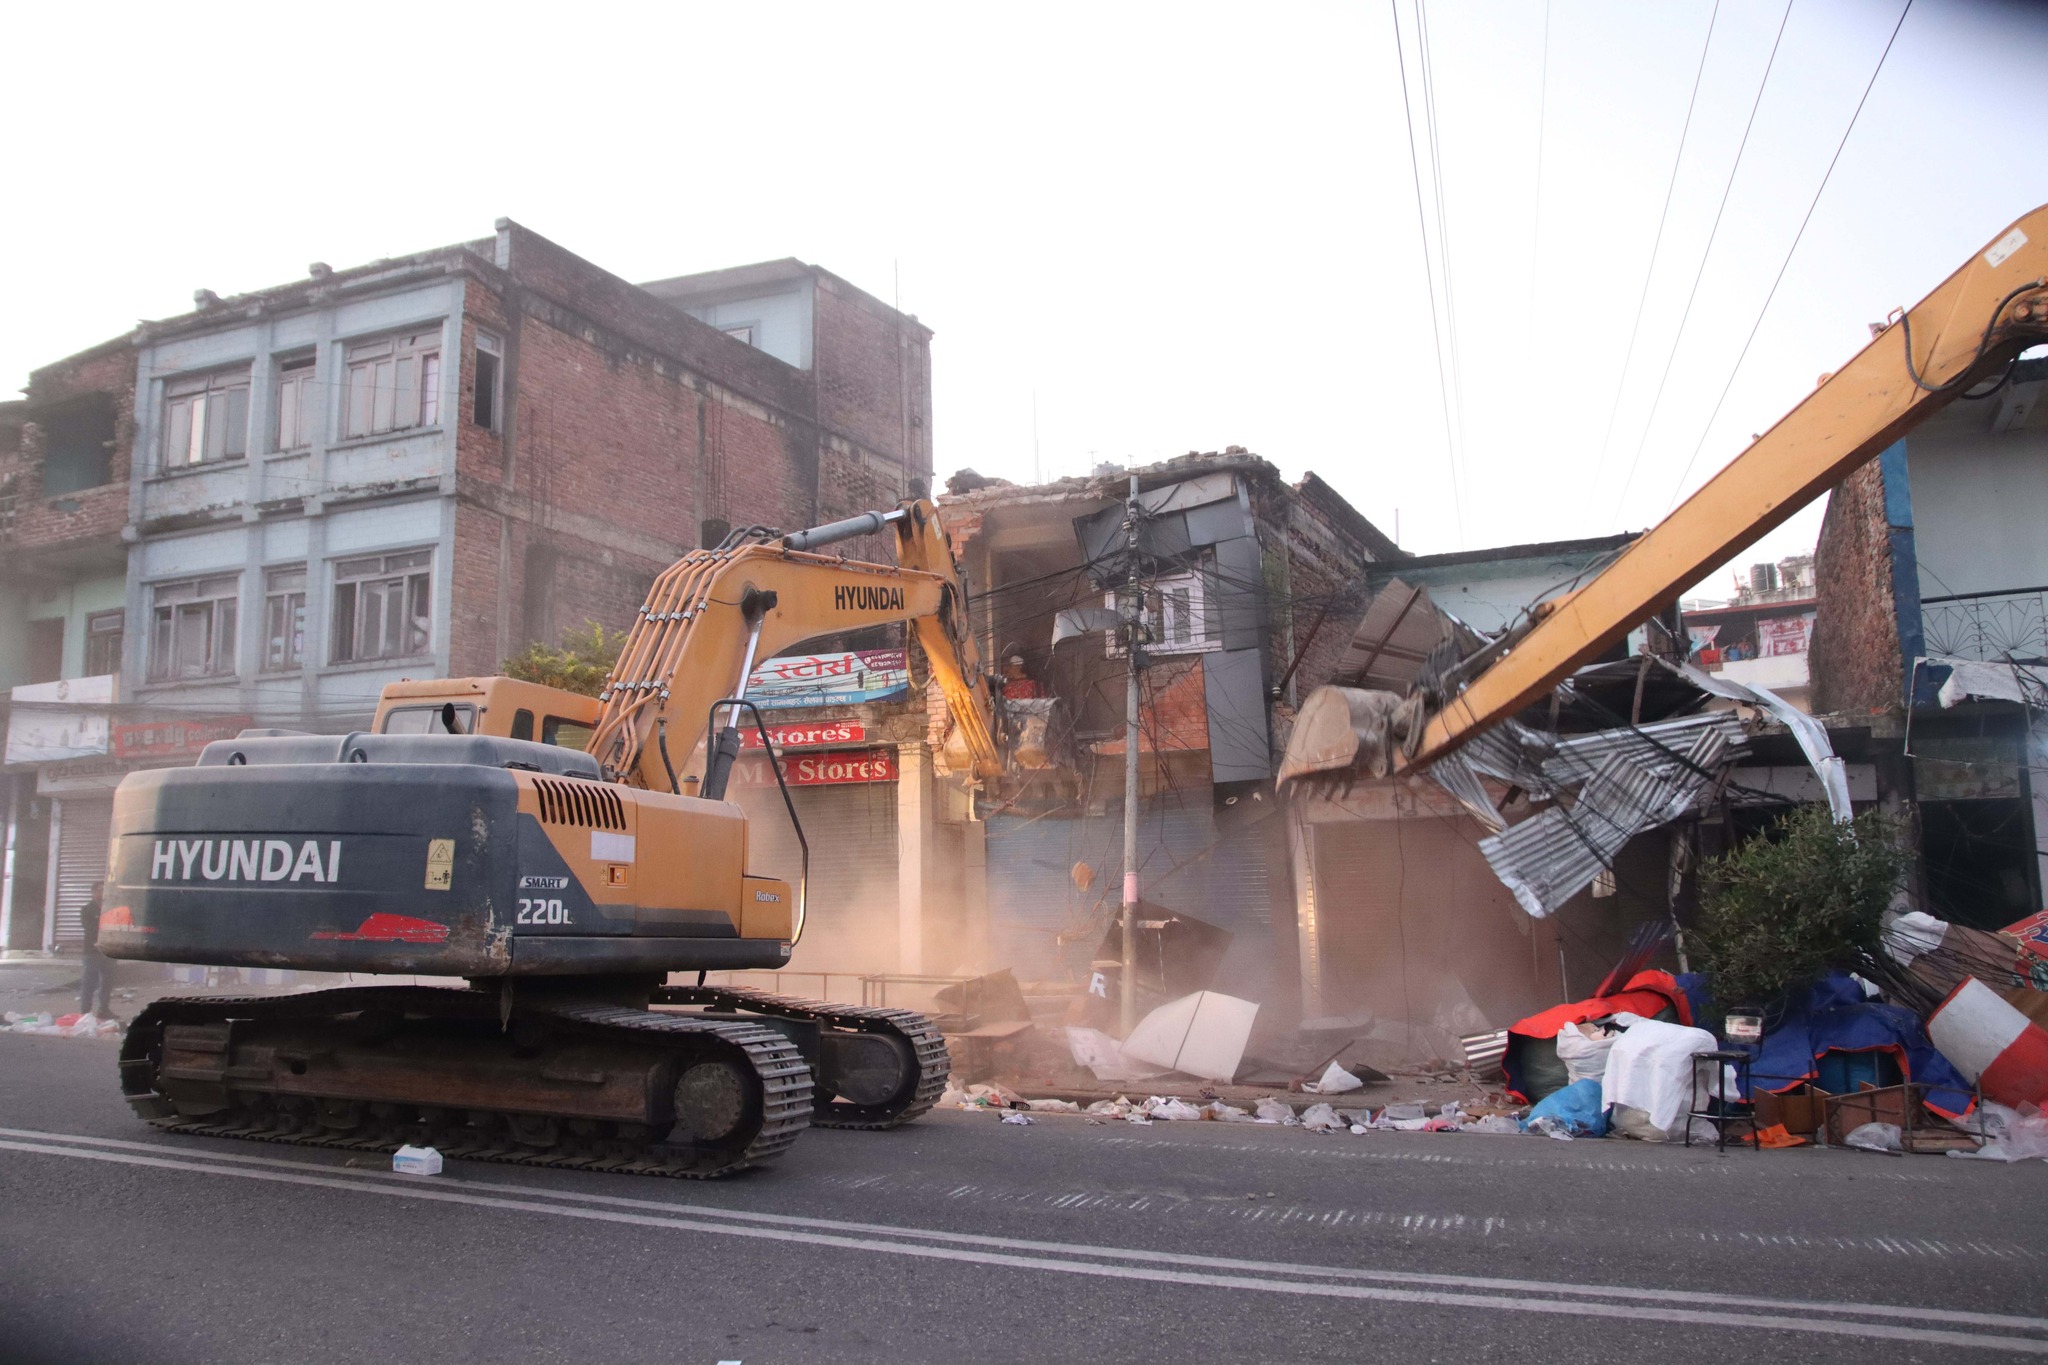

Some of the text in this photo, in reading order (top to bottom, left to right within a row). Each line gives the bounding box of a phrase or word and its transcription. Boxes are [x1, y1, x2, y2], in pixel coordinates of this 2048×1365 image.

[835, 585, 904, 610] HYUNDAI
[756, 727, 852, 746] Stores
[799, 759, 887, 782] Stores
[151, 840, 341, 882] HYUNDAI
[525, 877, 562, 888] SMART
[755, 890, 781, 902] Robex
[517, 899, 573, 924] 220L
